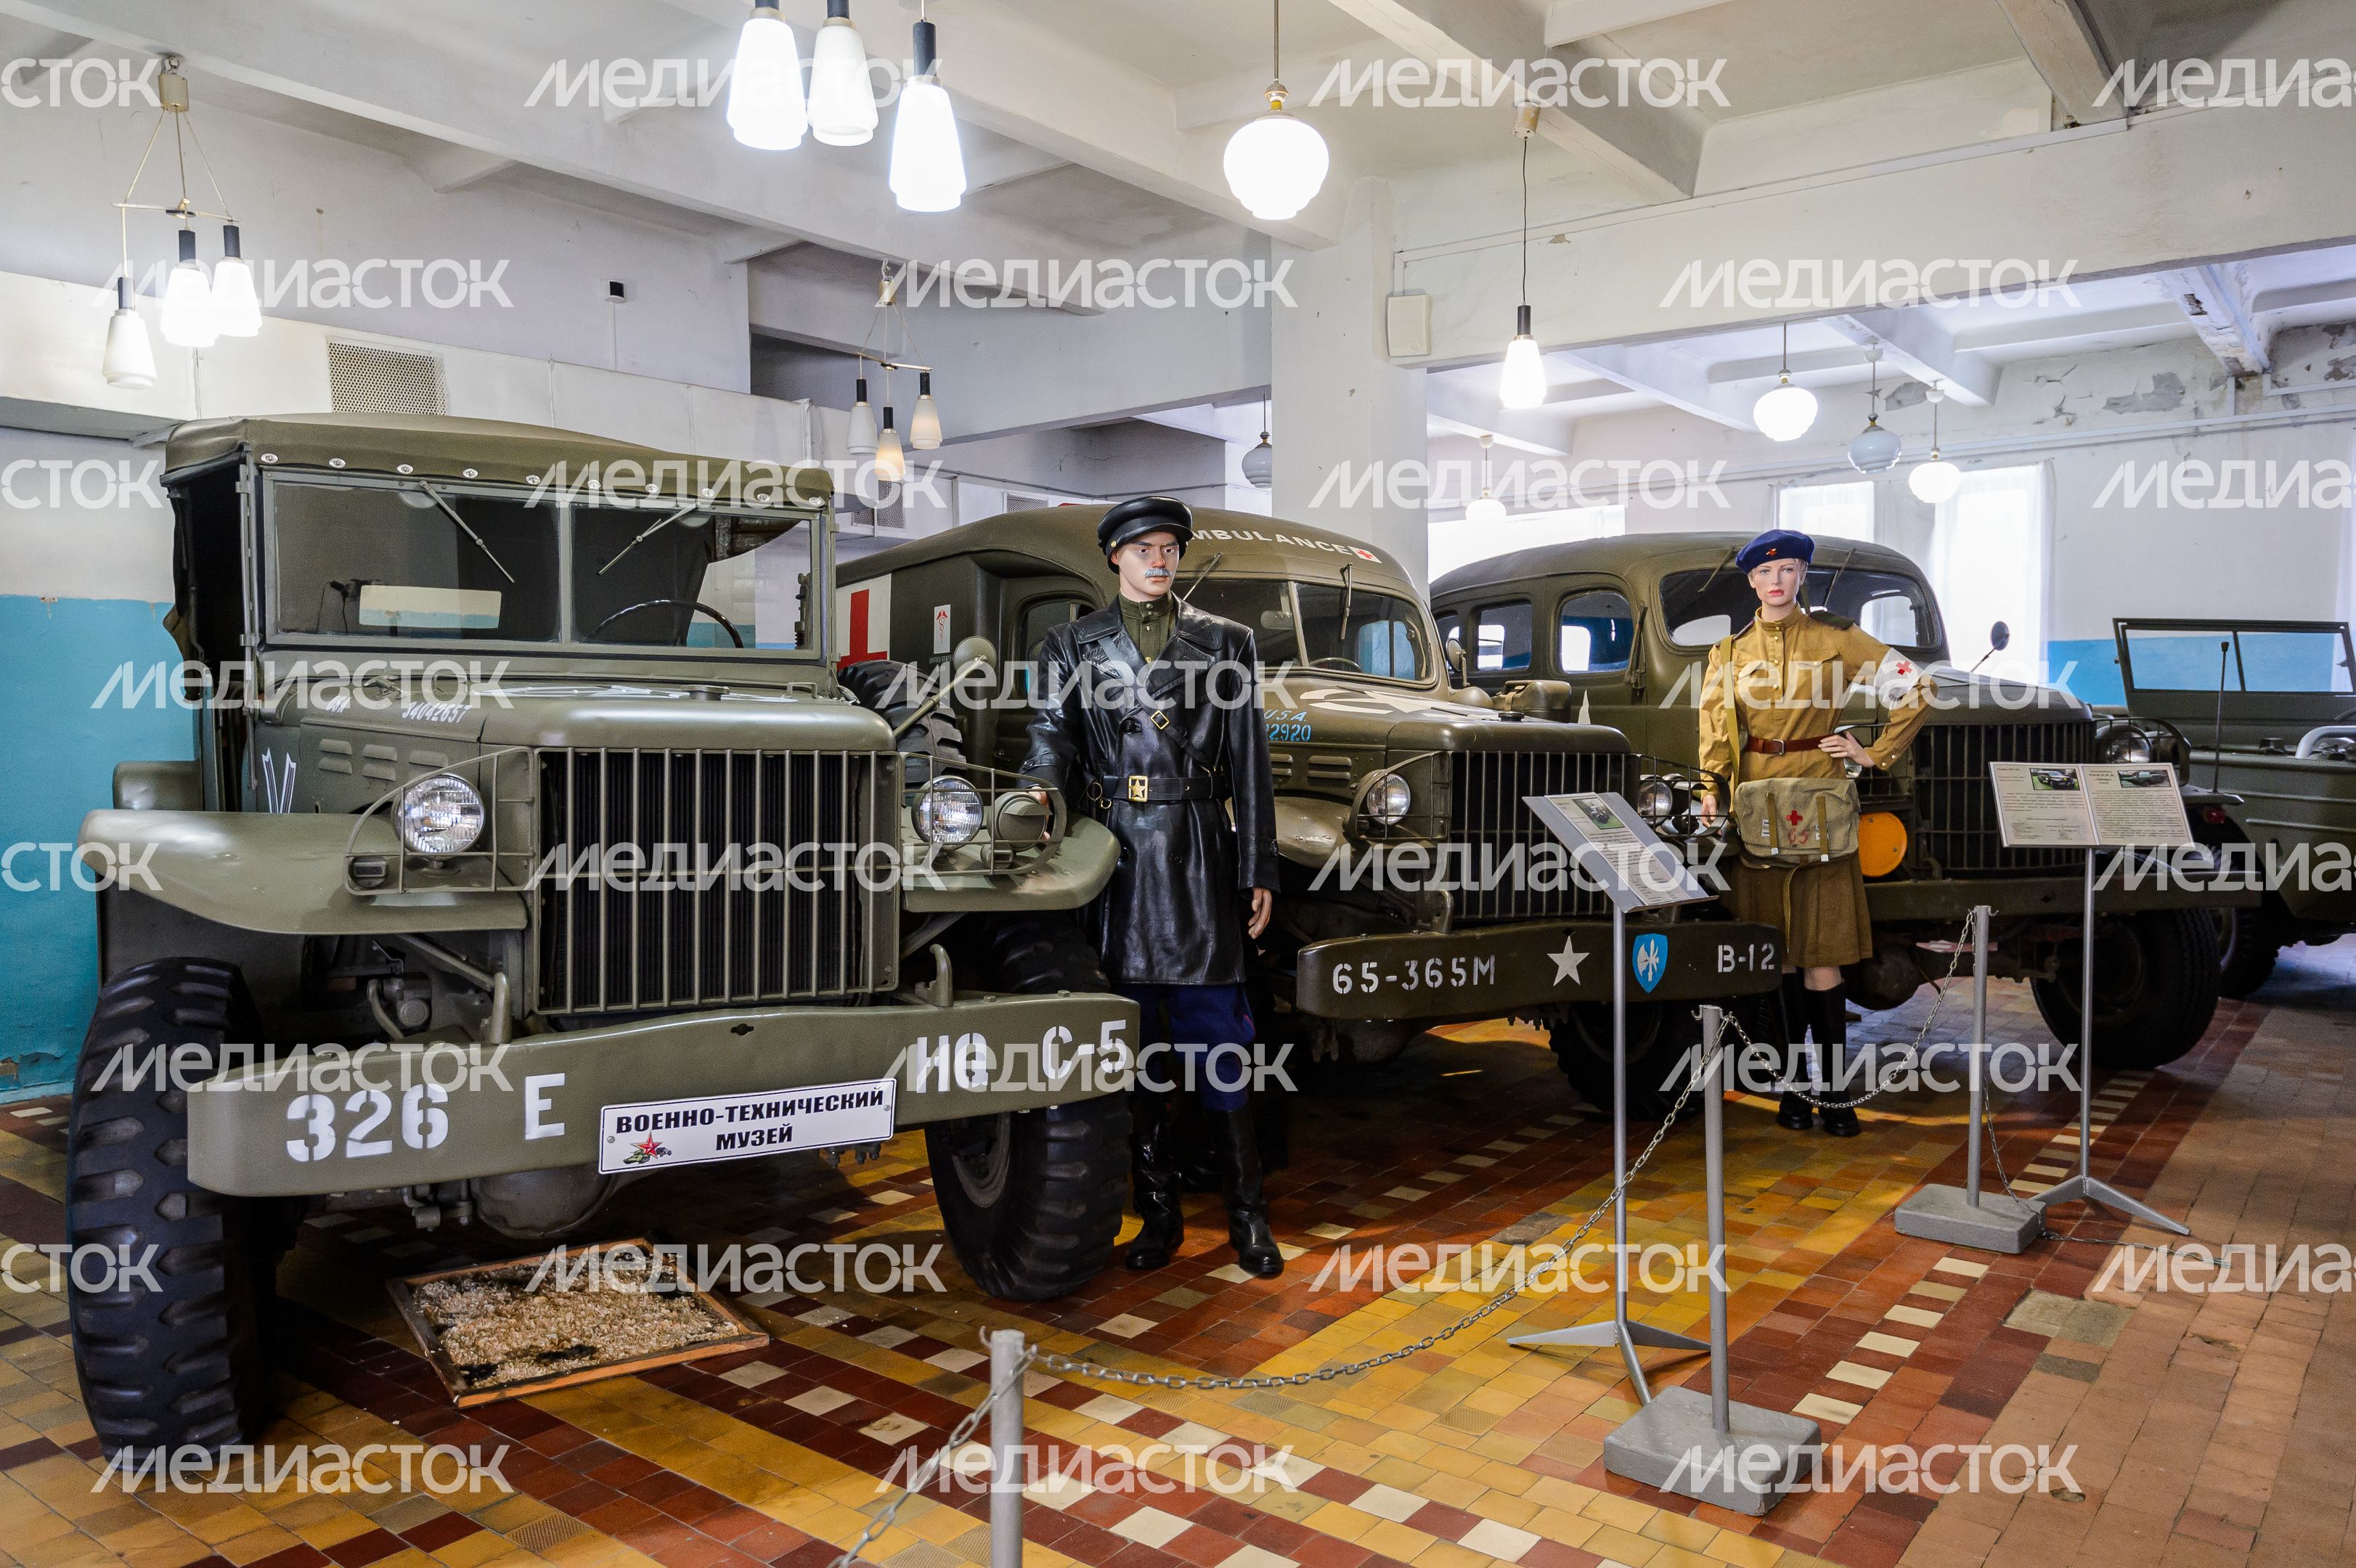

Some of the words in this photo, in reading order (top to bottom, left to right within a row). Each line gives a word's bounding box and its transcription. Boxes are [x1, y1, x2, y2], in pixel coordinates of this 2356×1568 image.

[1191, 529, 1353, 556] MBULANCE
[1333, 955, 1496, 995] 65-365M
[1718, 943, 1775, 973] B-12
[916, 1032, 989, 1093] HQ
[1043, 1019, 1128, 1080] C-5
[287, 1082, 449, 1161] 326
[524, 1073, 566, 1140] E
[616, 1087, 884, 1134] ВОЕННО-ТЕХНИЧЕСКИЙ
[716, 1123, 793, 1151] МУЗЕЙ
